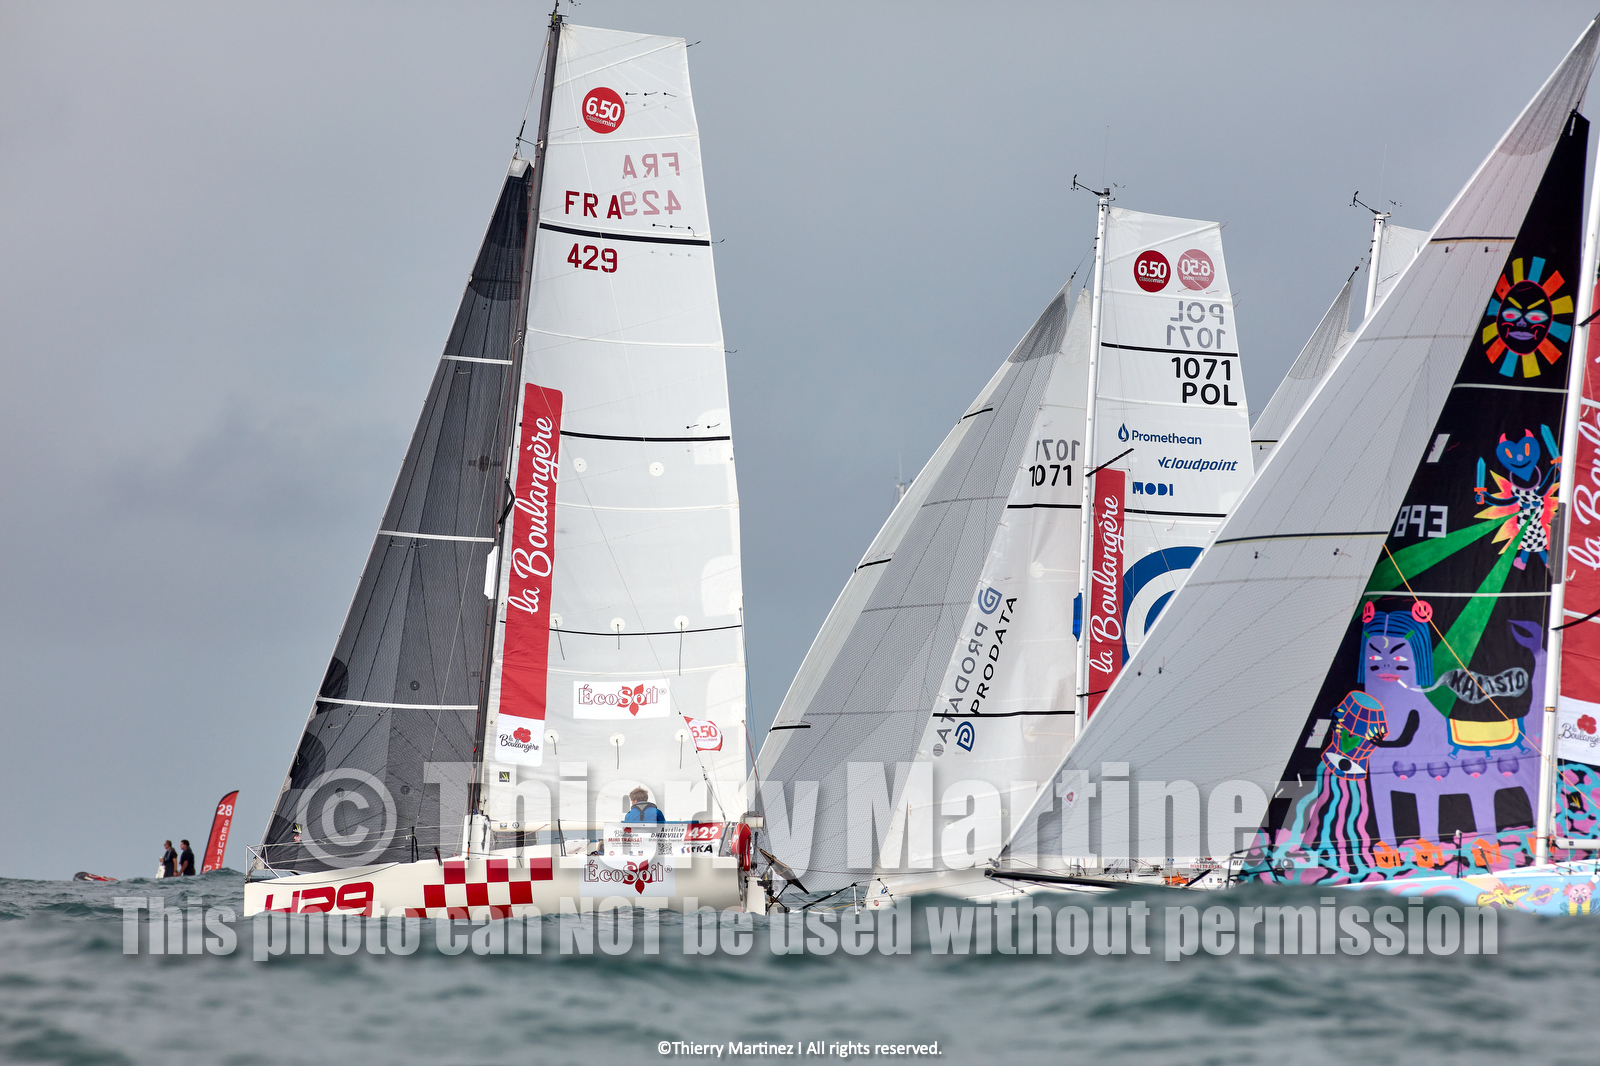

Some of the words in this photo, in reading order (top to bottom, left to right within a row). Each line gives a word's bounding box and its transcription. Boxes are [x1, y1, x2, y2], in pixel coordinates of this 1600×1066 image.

[586, 97, 621, 121] 6.50
[564, 190, 622, 220] FRA
[567, 243, 618, 273] 429
[1138, 260, 1167, 278] 6.50
[1171, 356, 1231, 381] 1071
[1182, 382, 1238, 406] POL
[1131, 430, 1202, 445] Promethean
[1028, 464, 1072, 487] 1071
[511, 416, 560, 579] Boulangère
[1132, 481, 1174, 497] MODI
[1393, 505, 1448, 538] 893
[1090, 495, 1125, 644] Boulangère
[507, 586, 540, 615] la
[970, 597, 1018, 715] PRODATA
[1089, 649, 1113, 675] la
[499, 733, 539, 753] Boulangère
[217, 804, 233, 816] 28
[688, 826, 719, 839] 429
